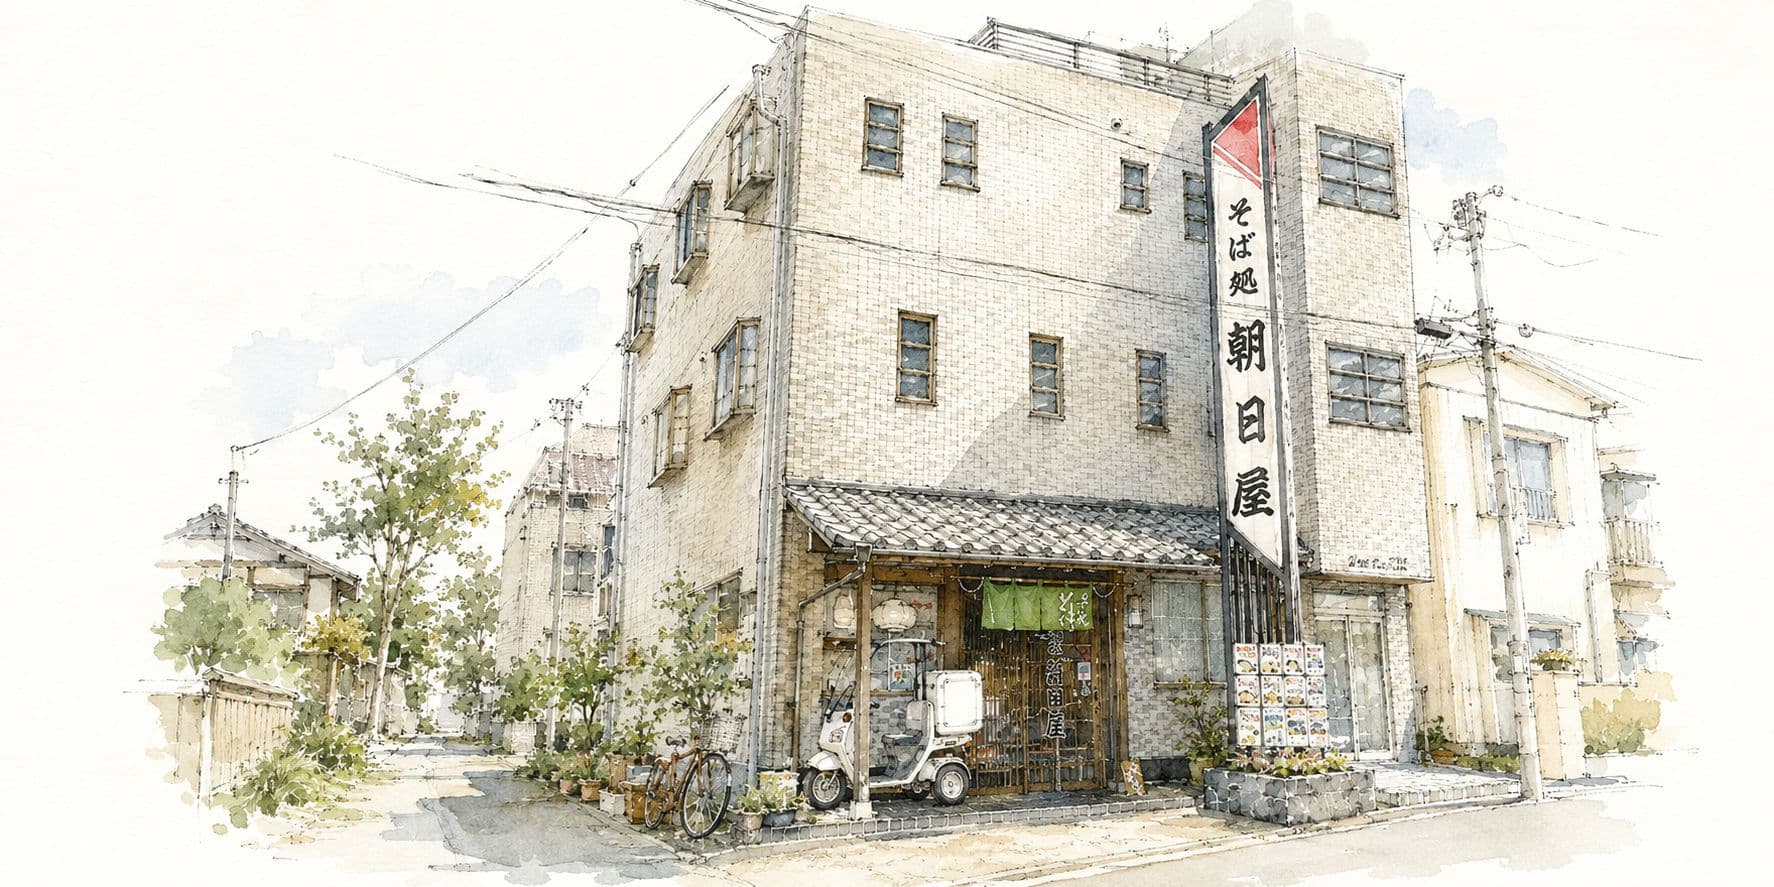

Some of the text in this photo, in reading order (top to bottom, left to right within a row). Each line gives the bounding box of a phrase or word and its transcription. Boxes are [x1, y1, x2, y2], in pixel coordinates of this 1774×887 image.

[1229, 198, 1258, 296] そば処
[1227, 319, 1274, 517] 朝日屋
